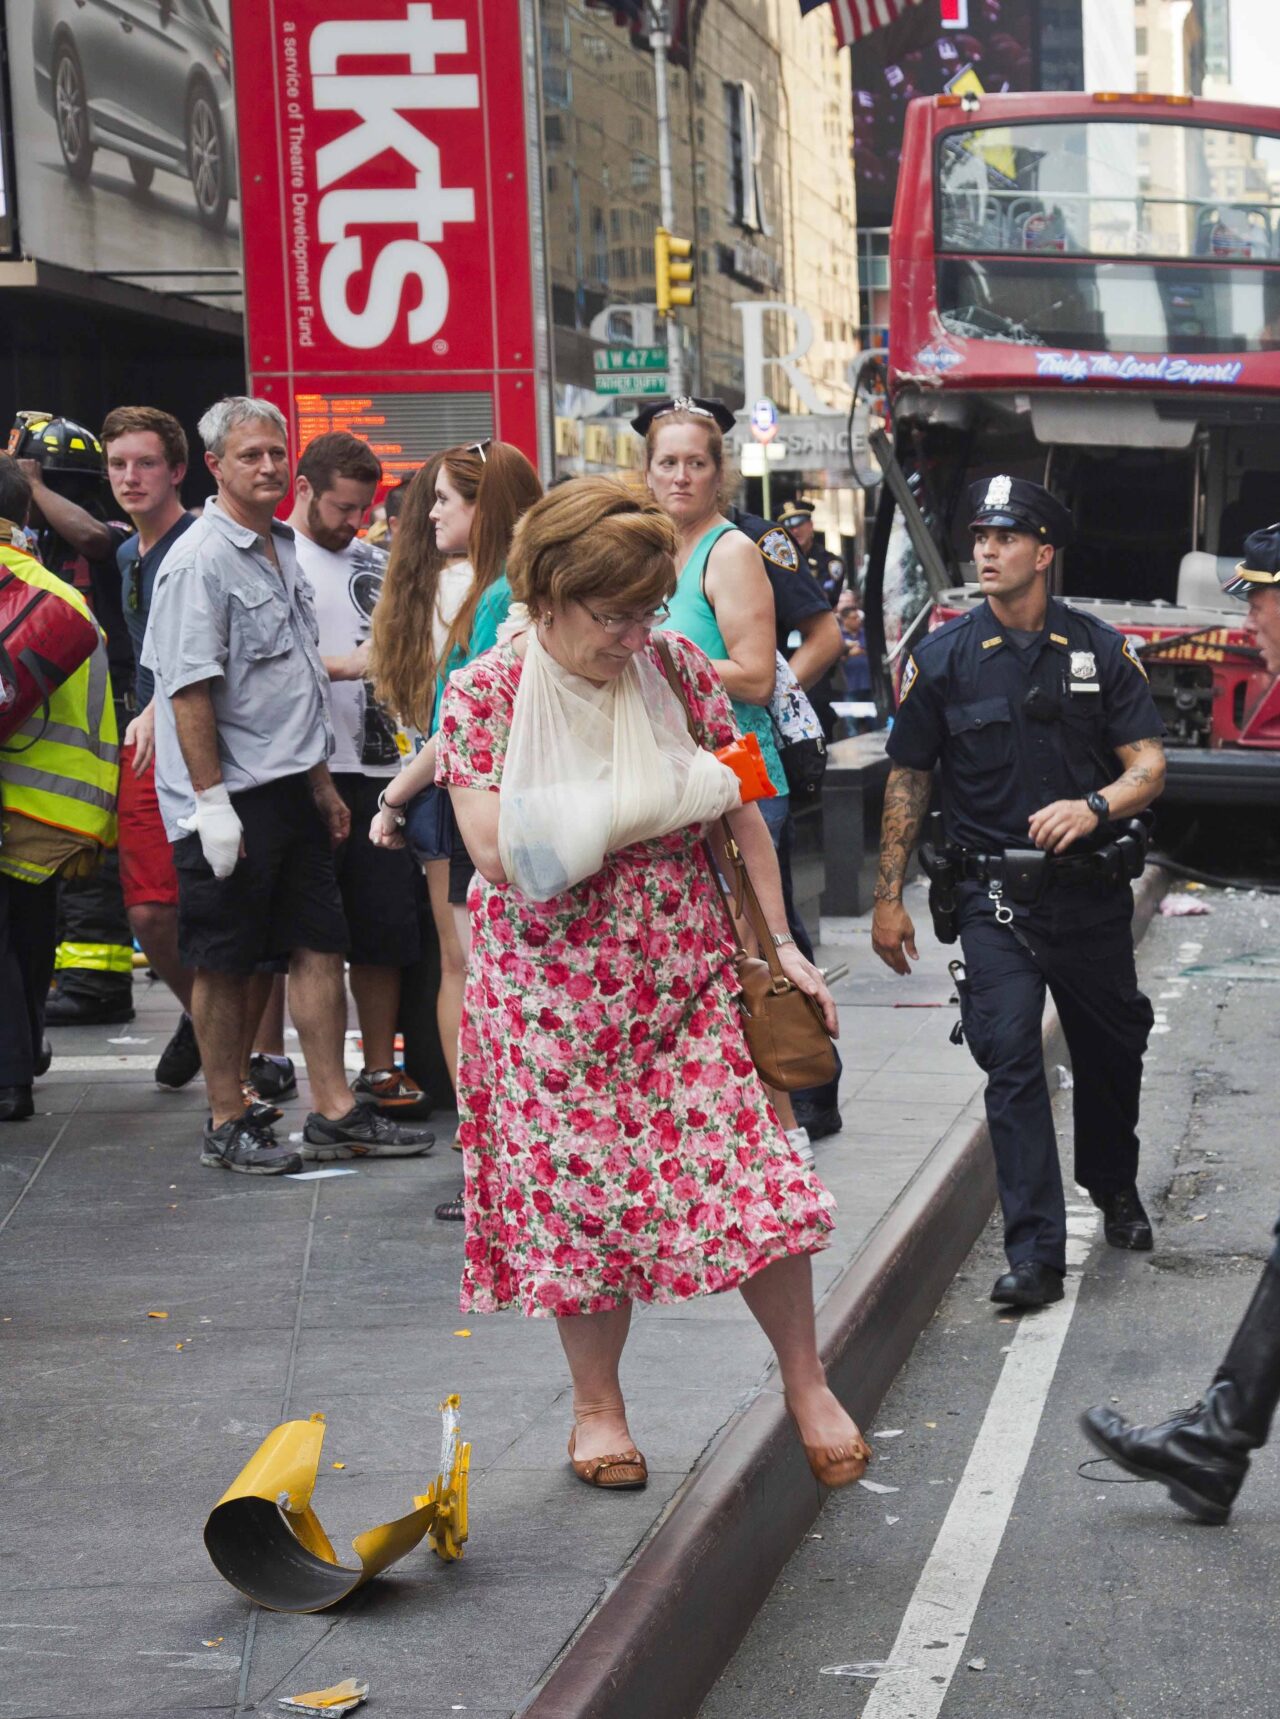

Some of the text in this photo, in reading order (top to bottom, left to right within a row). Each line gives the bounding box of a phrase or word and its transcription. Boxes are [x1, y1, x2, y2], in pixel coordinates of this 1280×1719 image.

[282, 21, 314, 347] a service of Theatre Development Fund
[309, 3, 479, 349] tkts
[611, 350, 623, 368] W
[627, 350, 648, 367] 47
[1116, 354, 1168, 378] Local
